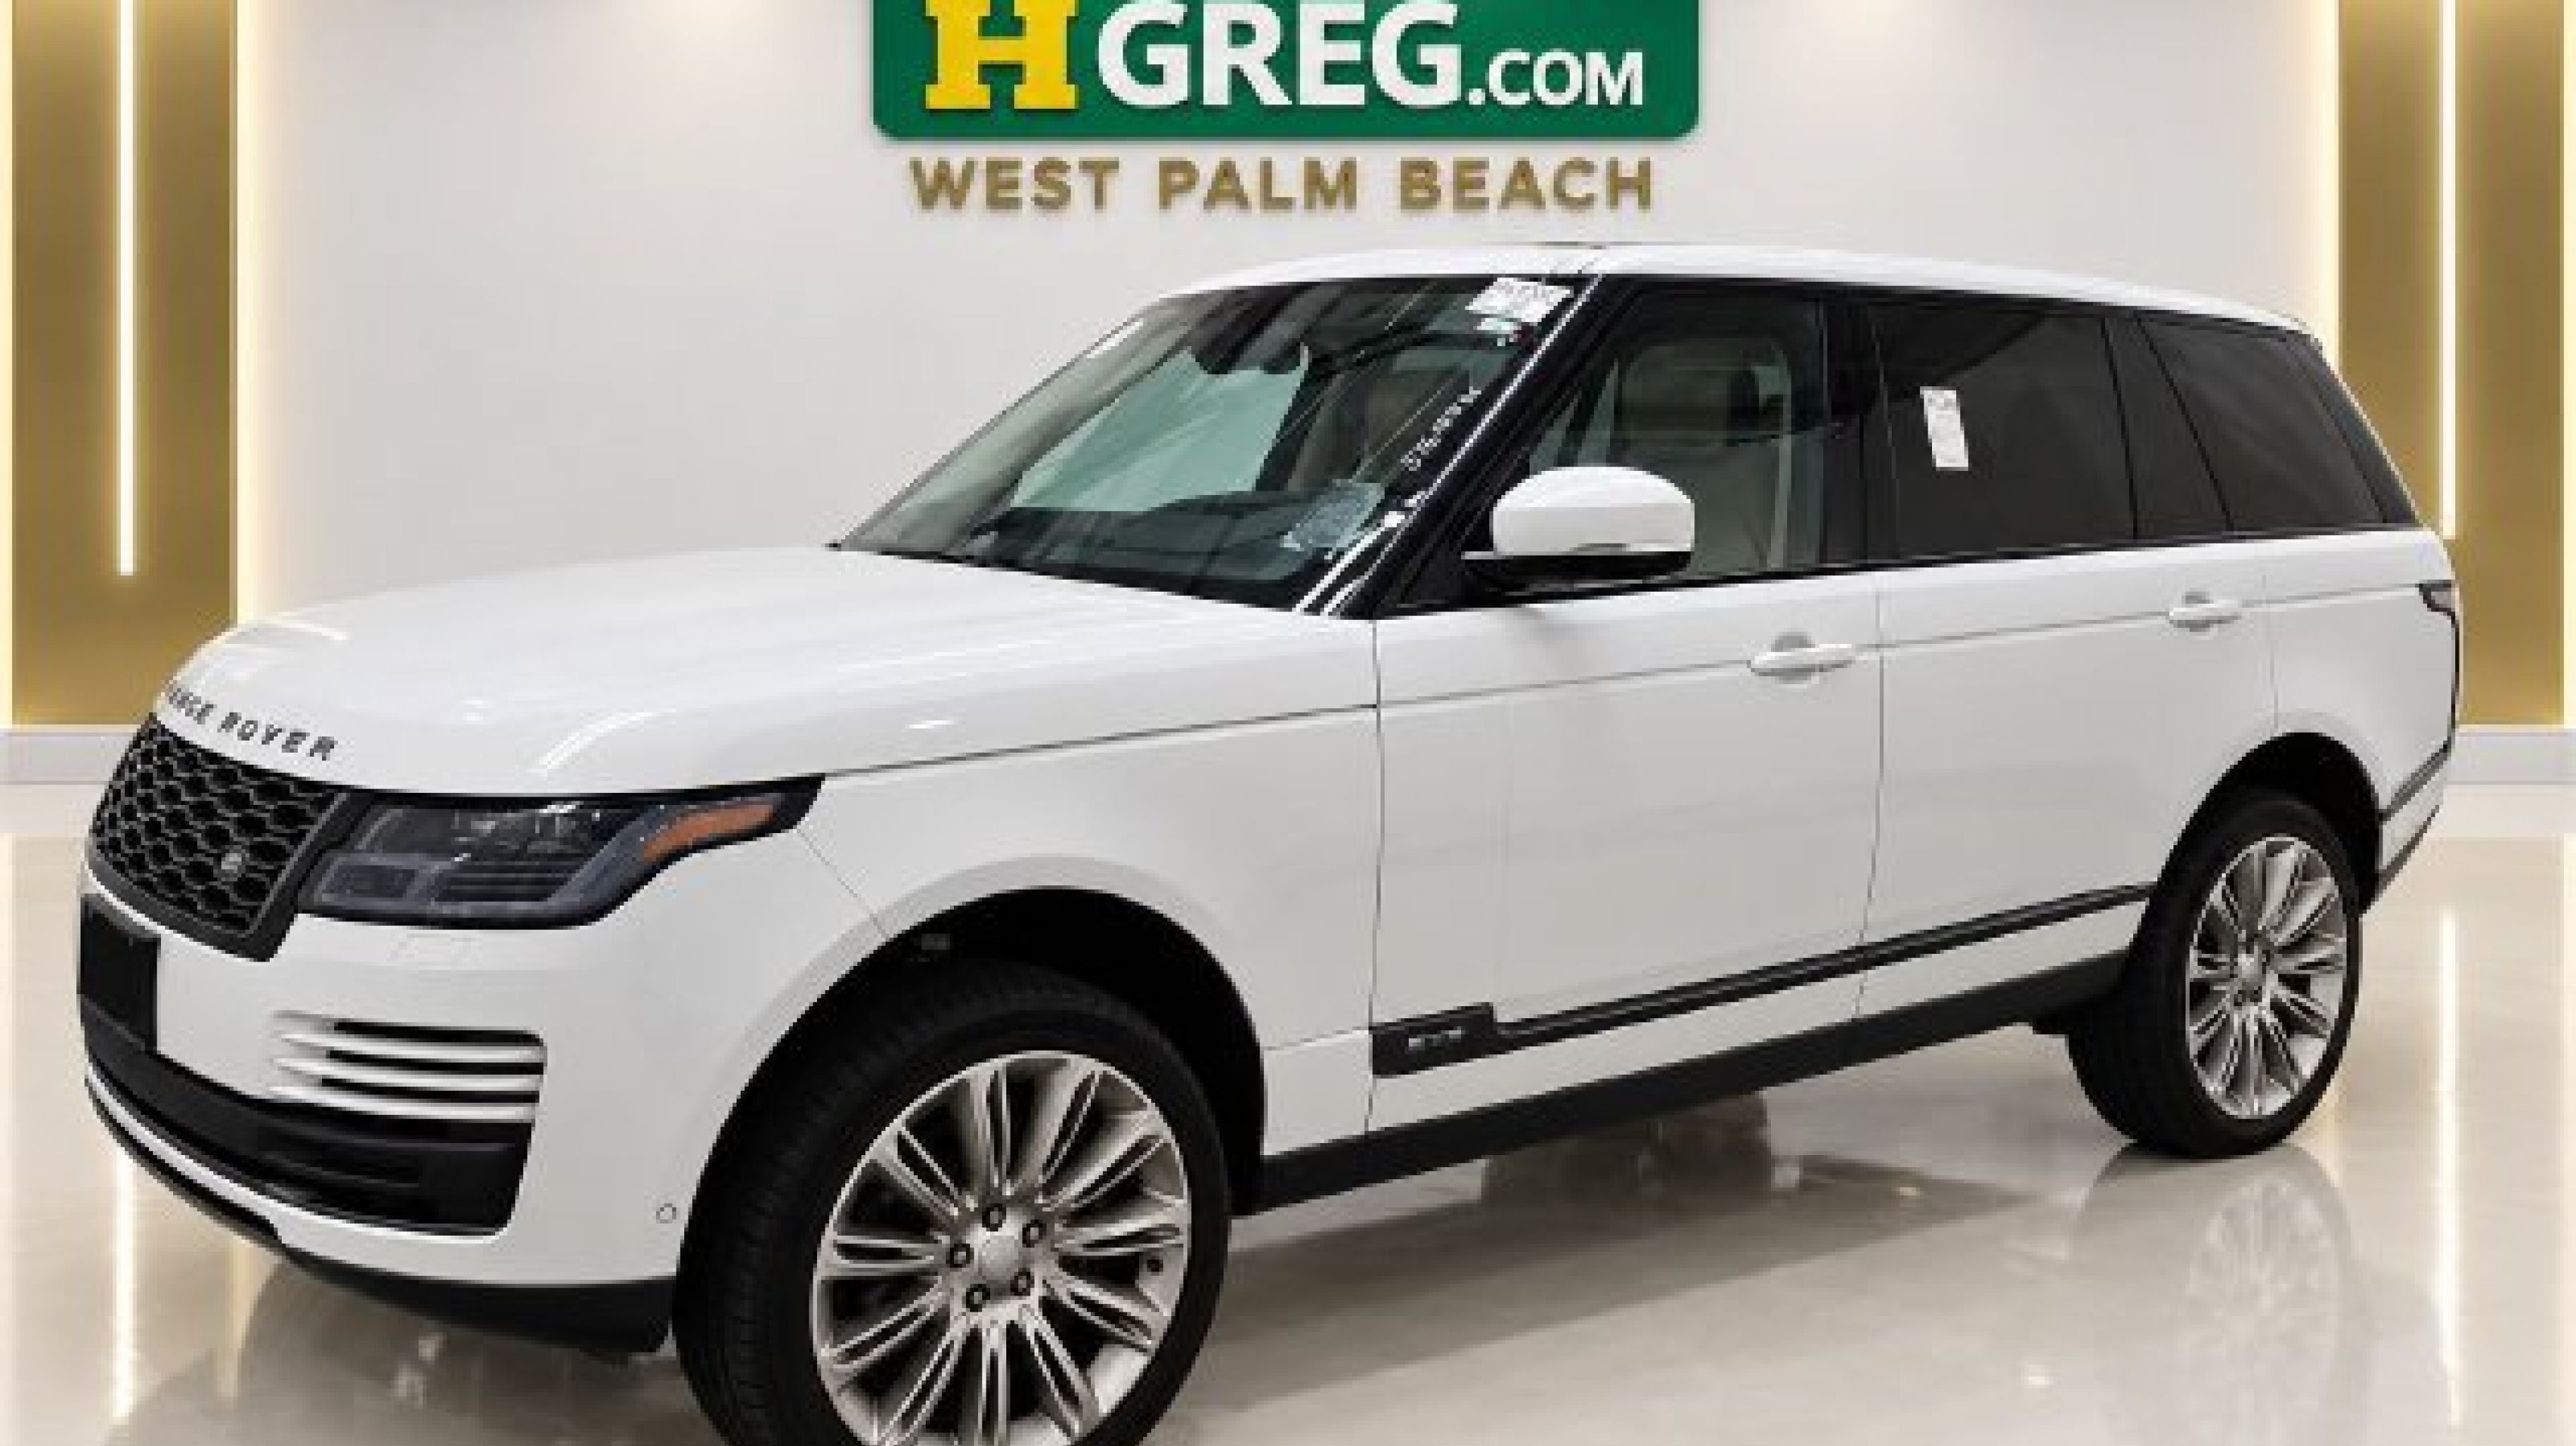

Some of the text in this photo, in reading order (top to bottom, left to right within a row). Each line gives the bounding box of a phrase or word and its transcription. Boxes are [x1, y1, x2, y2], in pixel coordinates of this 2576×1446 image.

[910, 157, 1652, 213] WEST PALM BEACH
[217, 712, 338, 761] ROVER
